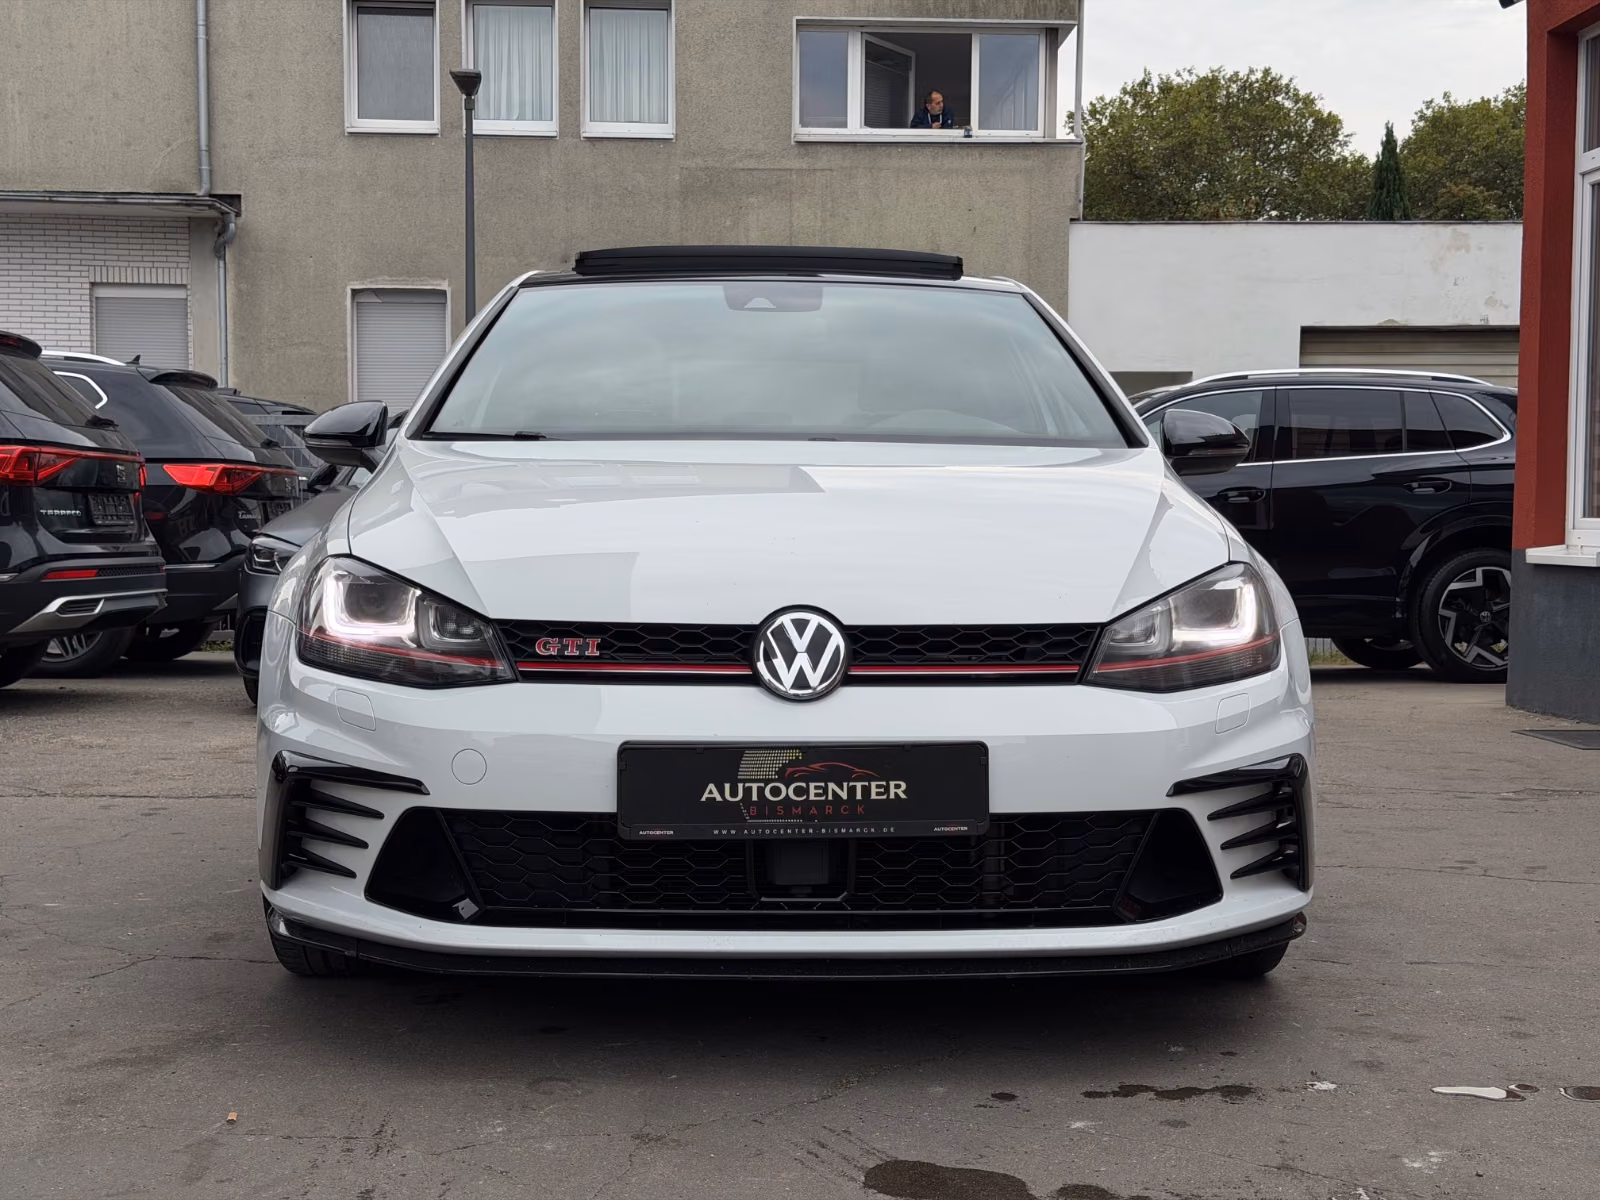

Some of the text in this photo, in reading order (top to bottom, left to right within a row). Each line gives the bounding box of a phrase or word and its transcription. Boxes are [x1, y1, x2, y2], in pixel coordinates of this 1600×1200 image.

[535, 637, 600, 656] GTI
[700, 780, 908, 802] AUTOCENTER
[750, 804, 865, 816] BISMARCK
